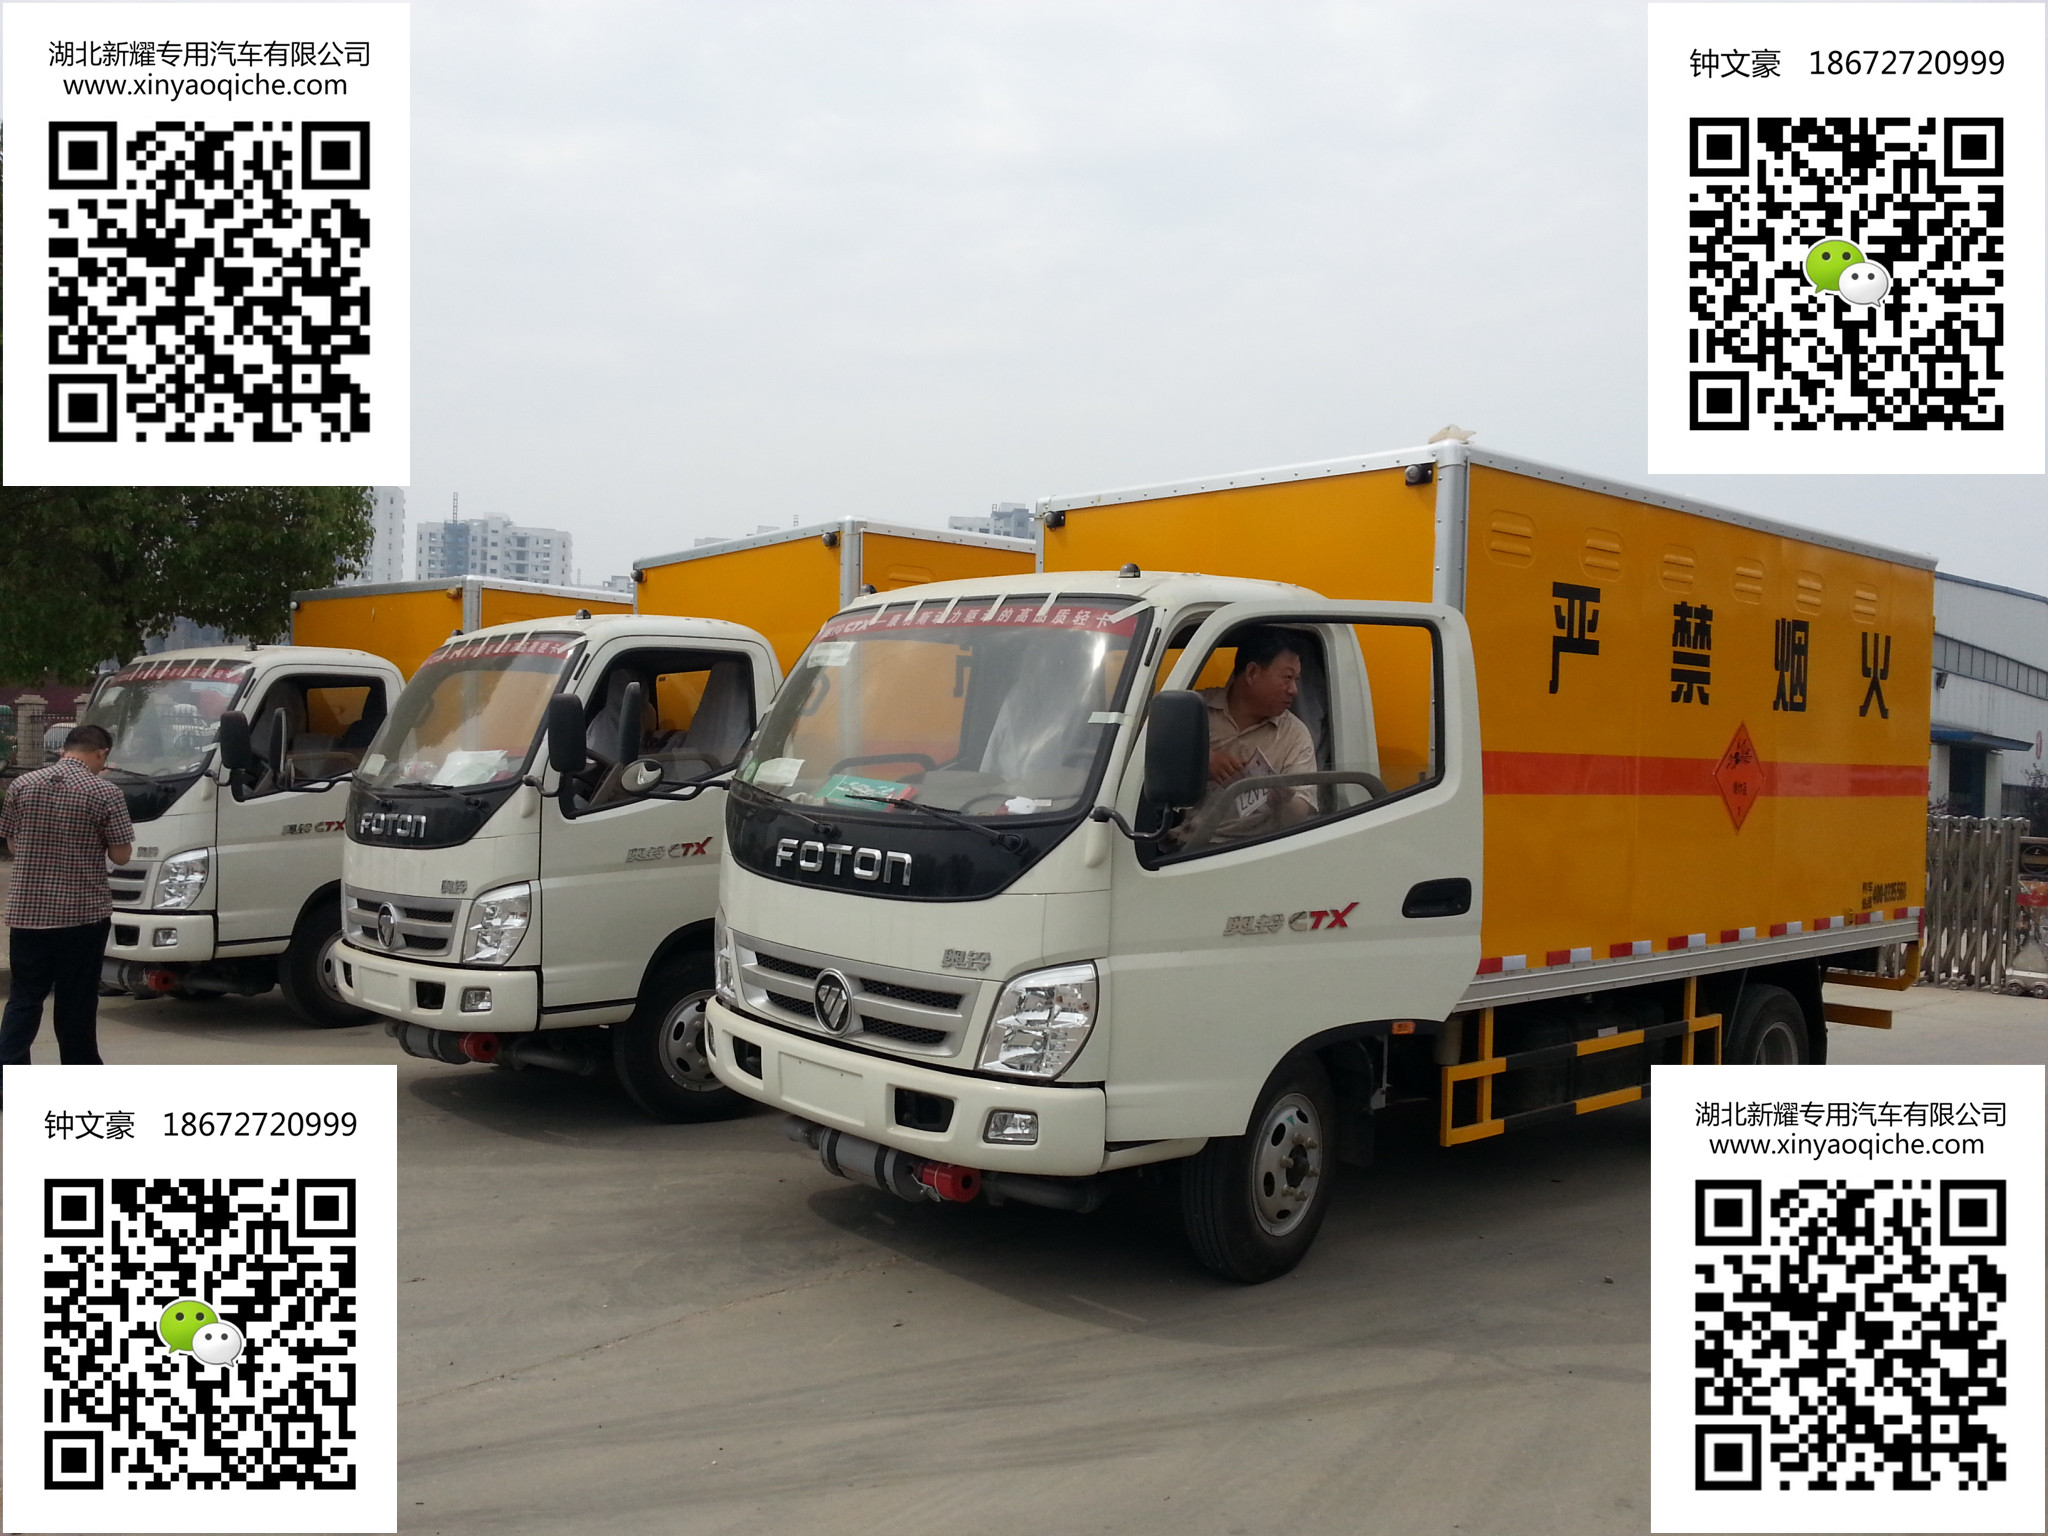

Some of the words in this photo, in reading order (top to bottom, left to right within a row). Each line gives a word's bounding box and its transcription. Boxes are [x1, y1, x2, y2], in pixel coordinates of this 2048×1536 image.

[1549, 581, 1891, 719] 严禁烟火
[360, 812, 427, 839] FOTON
[668, 836, 714, 858] CTX
[776, 838, 913, 886] FOTON
[1288, 902, 1361, 932] CTX
